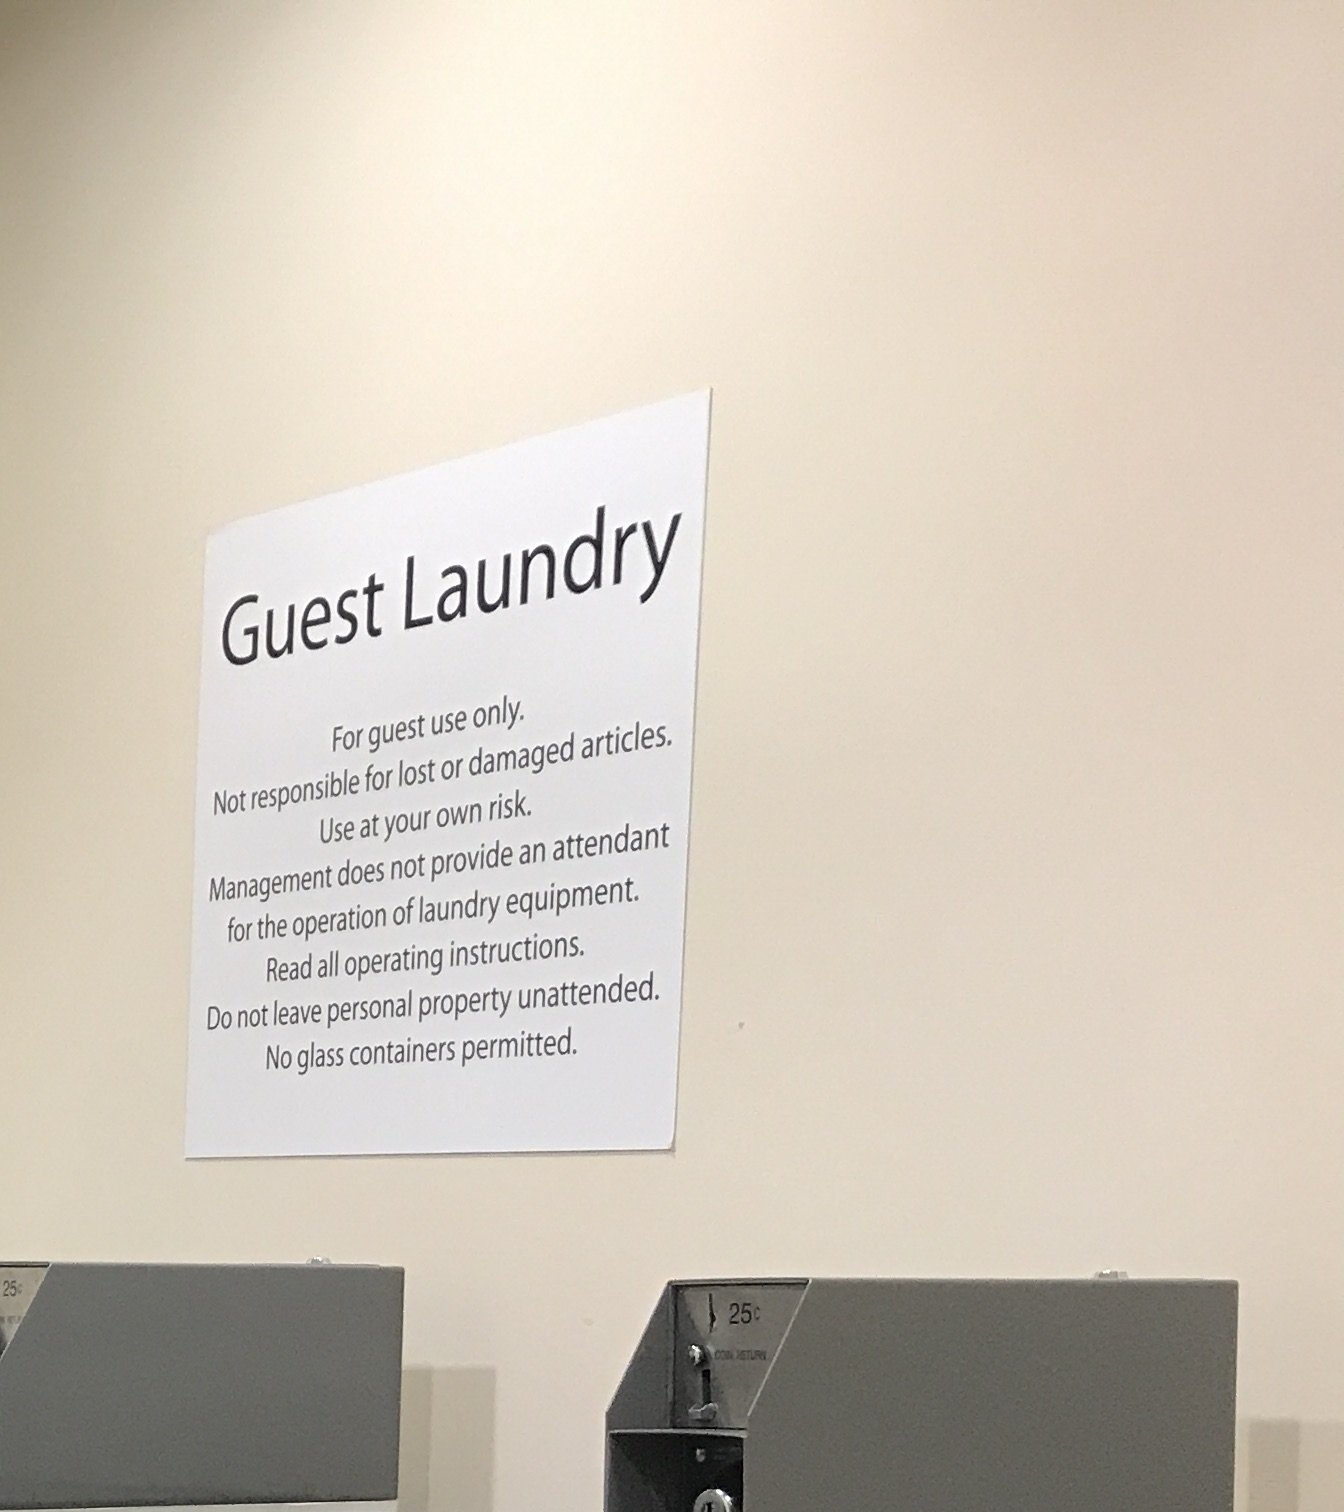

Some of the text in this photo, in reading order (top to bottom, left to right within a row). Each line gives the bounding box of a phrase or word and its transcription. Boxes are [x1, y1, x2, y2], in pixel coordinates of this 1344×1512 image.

[220, 503, 682, 666] Guest Laundry
[331, 693, 524, 754] For guest use only.
[212, 719, 673, 816] Not responsible for lost or damaged articles.
[319, 788, 532, 844] Use at your own risk.
[208, 821, 670, 903] Management does not provide an attendant
[226, 876, 640, 943] for the operation of laundry equipment.
[265, 931, 585, 983] Read all operating instructions.
[206, 969, 660, 1031] Do not leave personal property unattended.
[265, 1025, 577, 1076] No glass containers permitted.
